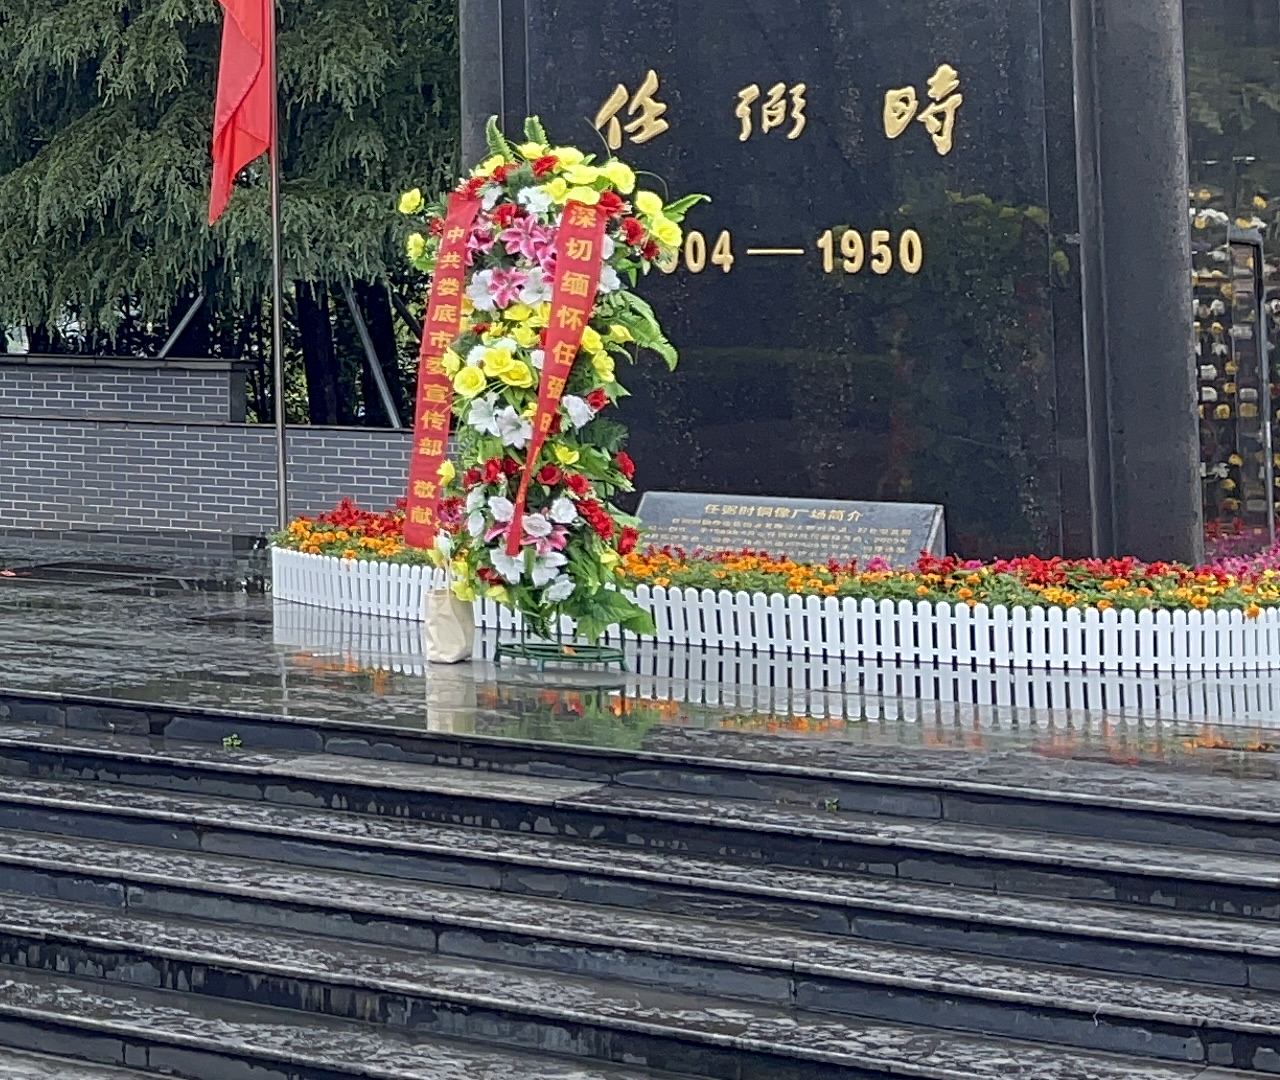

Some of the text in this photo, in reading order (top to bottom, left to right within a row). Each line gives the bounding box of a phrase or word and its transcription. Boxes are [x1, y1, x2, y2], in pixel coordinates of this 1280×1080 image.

[411, 226, 465, 525] 中共娄底市委宣传部 敬献
[704, 503, 864, 522] 任弼时铜像广场简介
